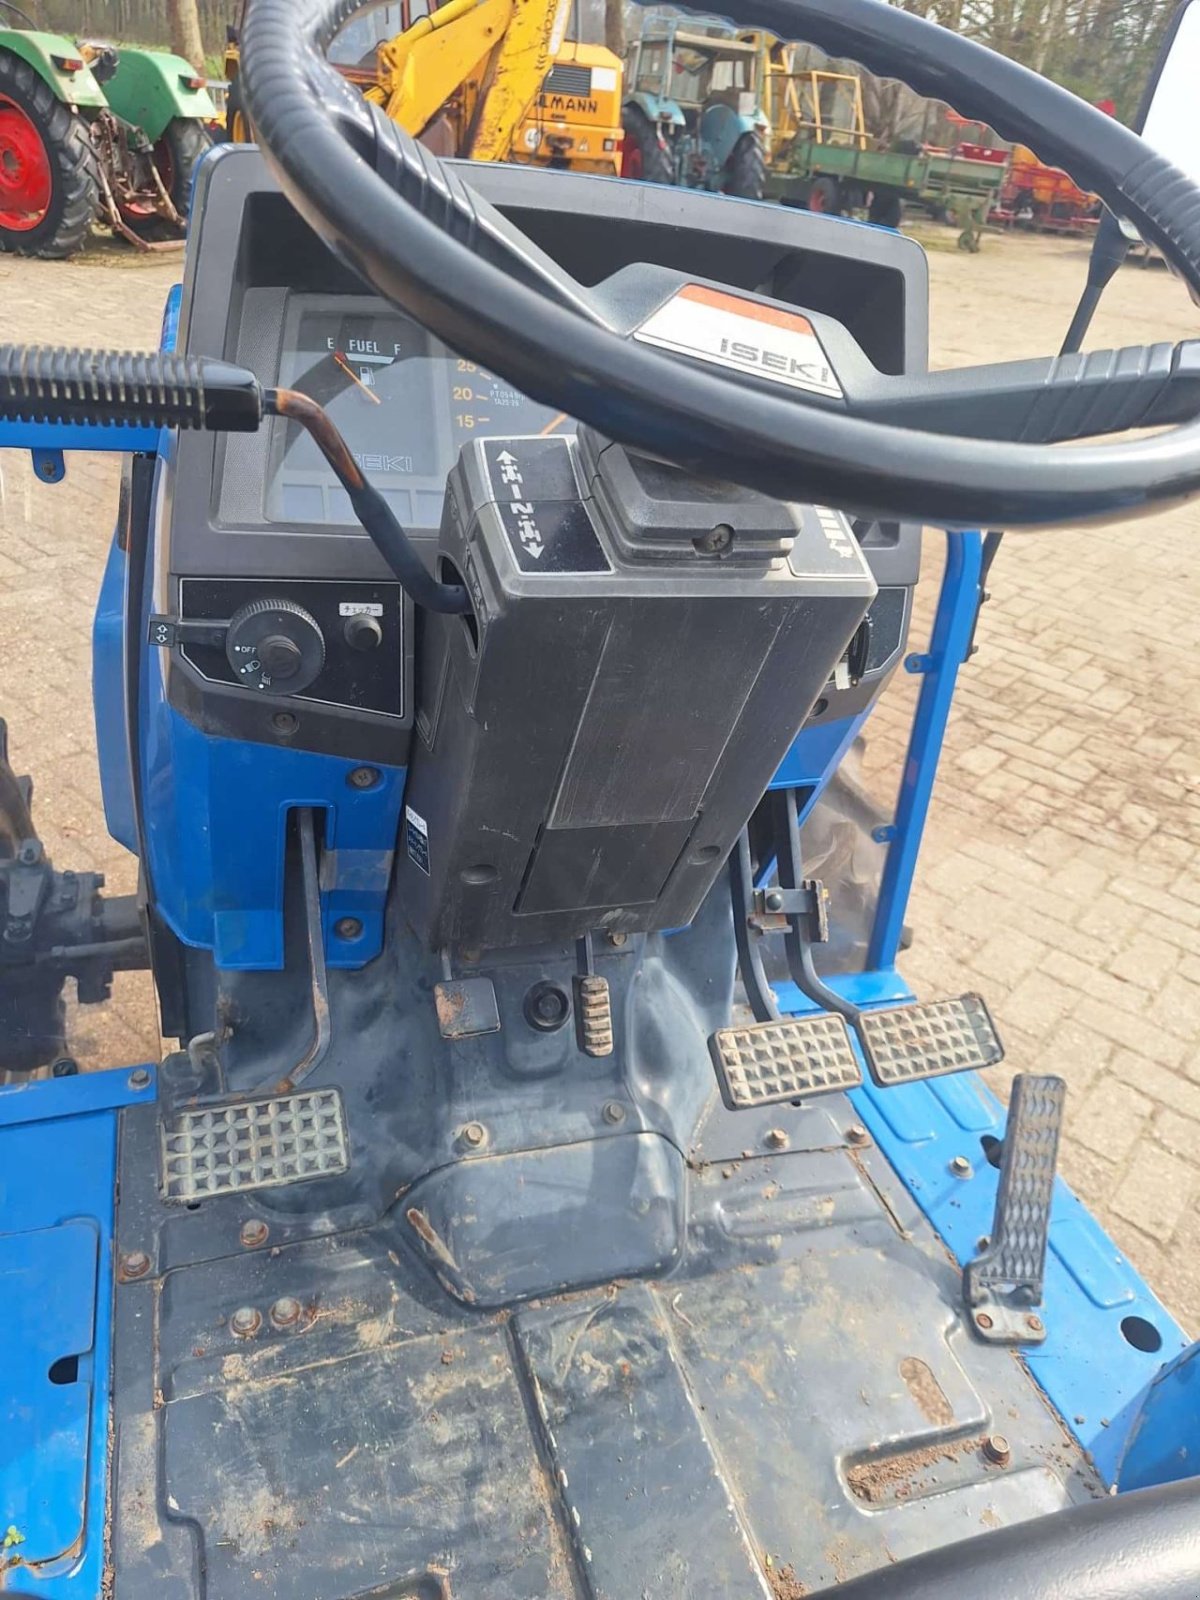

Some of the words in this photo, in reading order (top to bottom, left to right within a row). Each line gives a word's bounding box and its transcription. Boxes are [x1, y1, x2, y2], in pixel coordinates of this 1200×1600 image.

[327, 337, 335, 349] E
[349, 339, 381, 354] FUEL
[394, 343, 401, 355] F
[457, 359, 476, 372] 25
[720, 338, 828, 382] ISEKI
[453, 386, 474, 400] 20
[456, 415, 475, 428] 15
[241, 646, 257, 655] OFF
